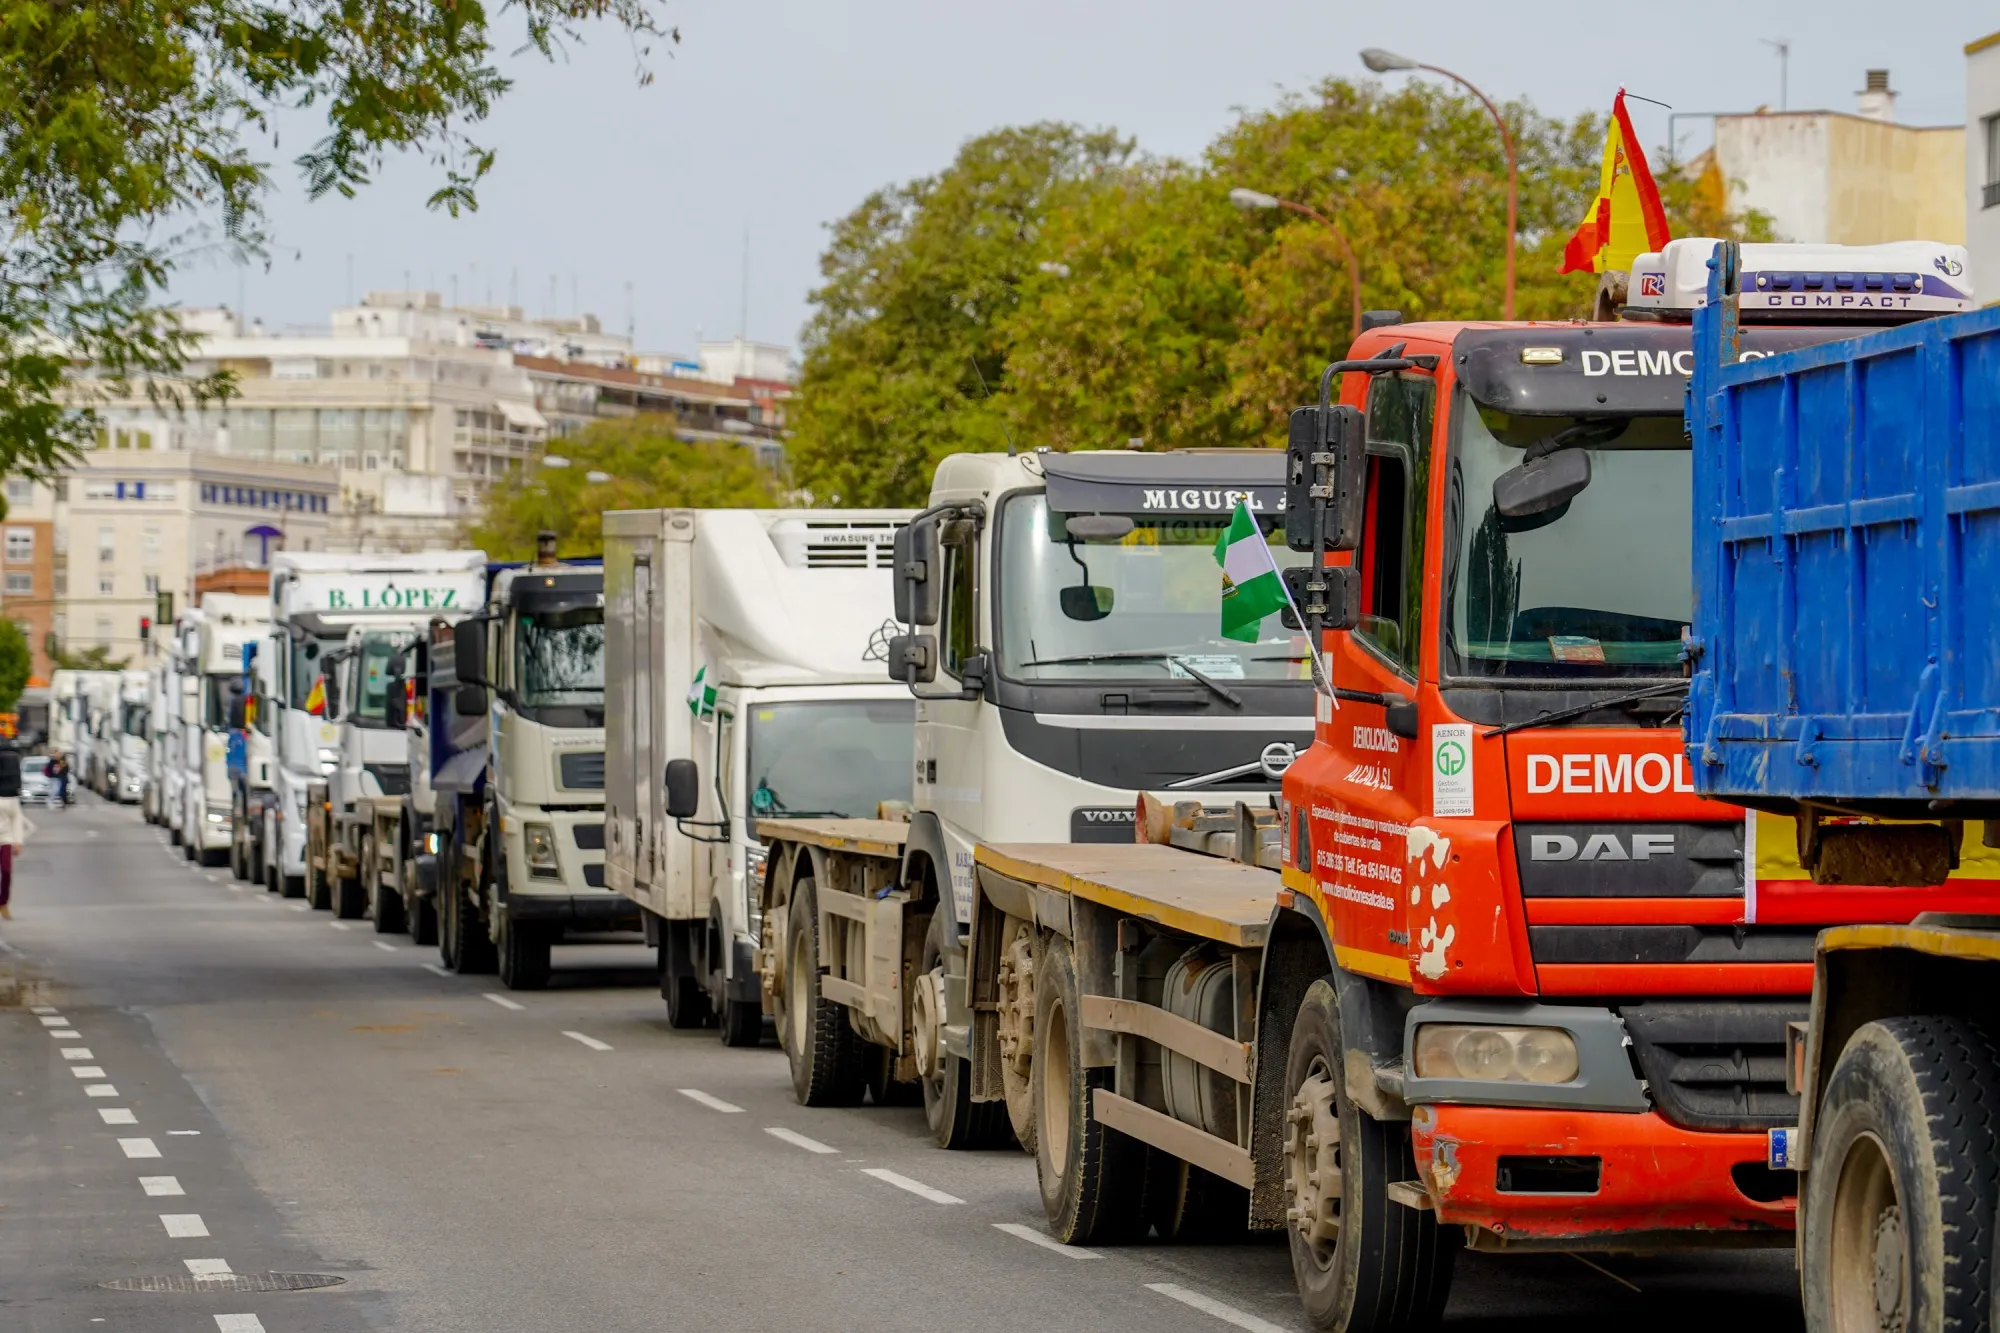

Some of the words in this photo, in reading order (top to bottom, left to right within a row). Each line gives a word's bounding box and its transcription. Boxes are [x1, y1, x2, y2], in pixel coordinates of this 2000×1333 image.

[1768, 295, 1911, 308] COMPACT
[1142, 489, 1264, 510] MIGUEL
[823, 534, 875, 542] HWASUNG
[329, 588, 353, 608] B.
[1353, 725, 1399, 753] DEMOLICIONES
[1436, 729, 1466, 738] AENOR
[1527, 753, 1695, 793] DEMOL
[1531, 834, 1675, 861] DAF
[1775, 1153, 1783, 1162] E
